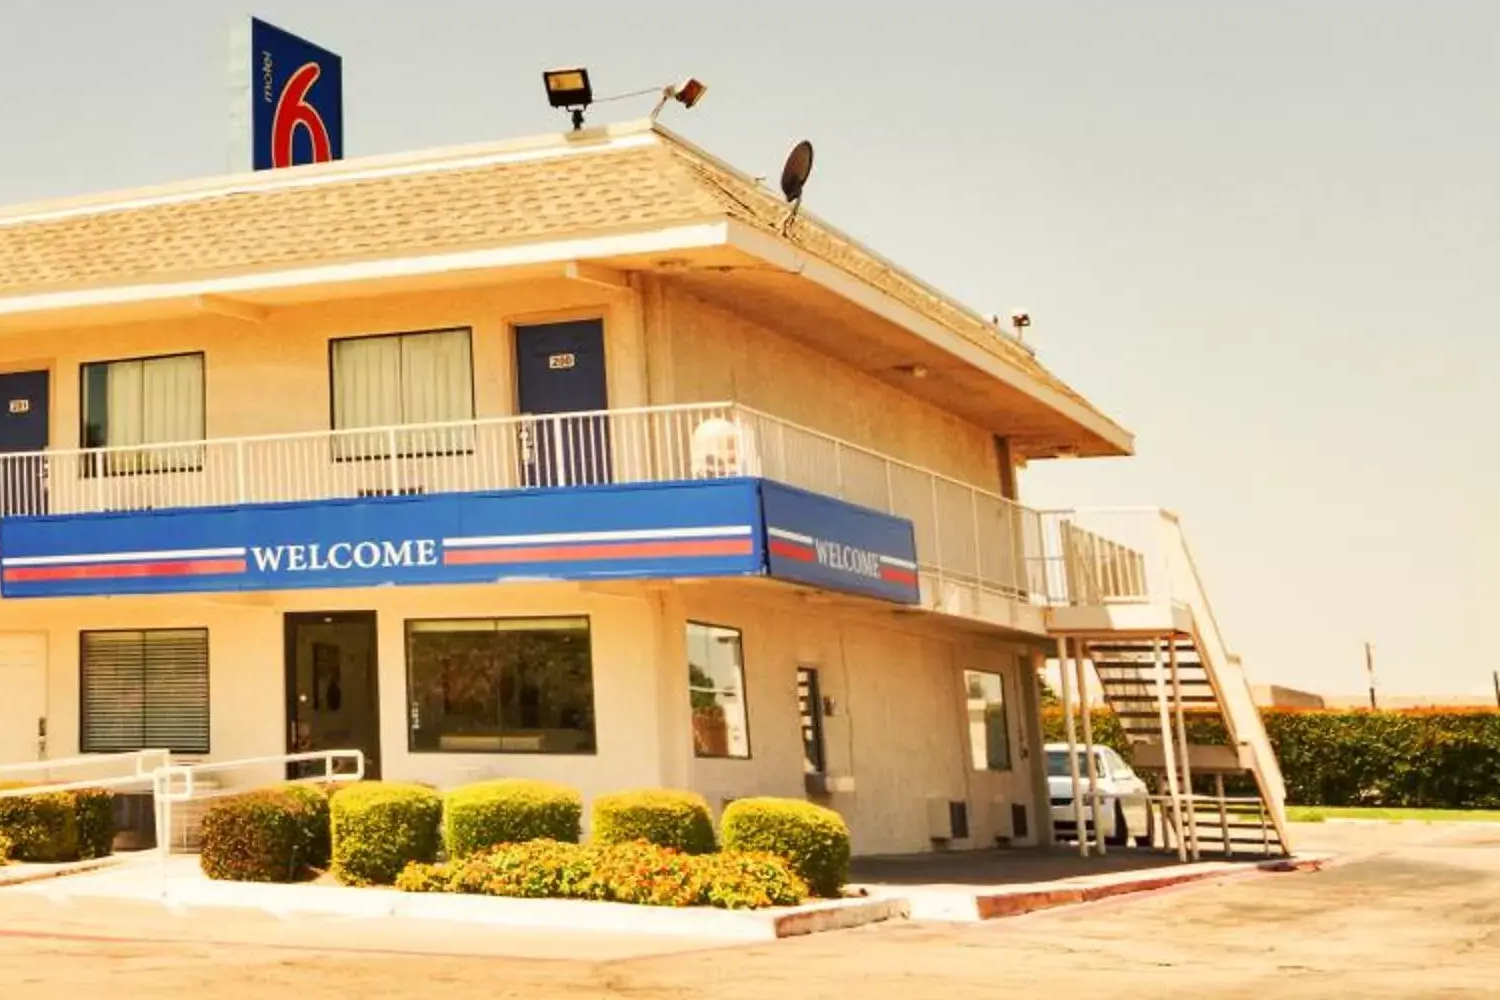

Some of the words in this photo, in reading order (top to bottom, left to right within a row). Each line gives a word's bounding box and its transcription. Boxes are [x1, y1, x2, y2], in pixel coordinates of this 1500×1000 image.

[261, 50, 273, 103] motel
[271, 61, 333, 169] 6
[250, 539, 437, 573] WELCOME
[815, 537, 881, 579] WELCOME
